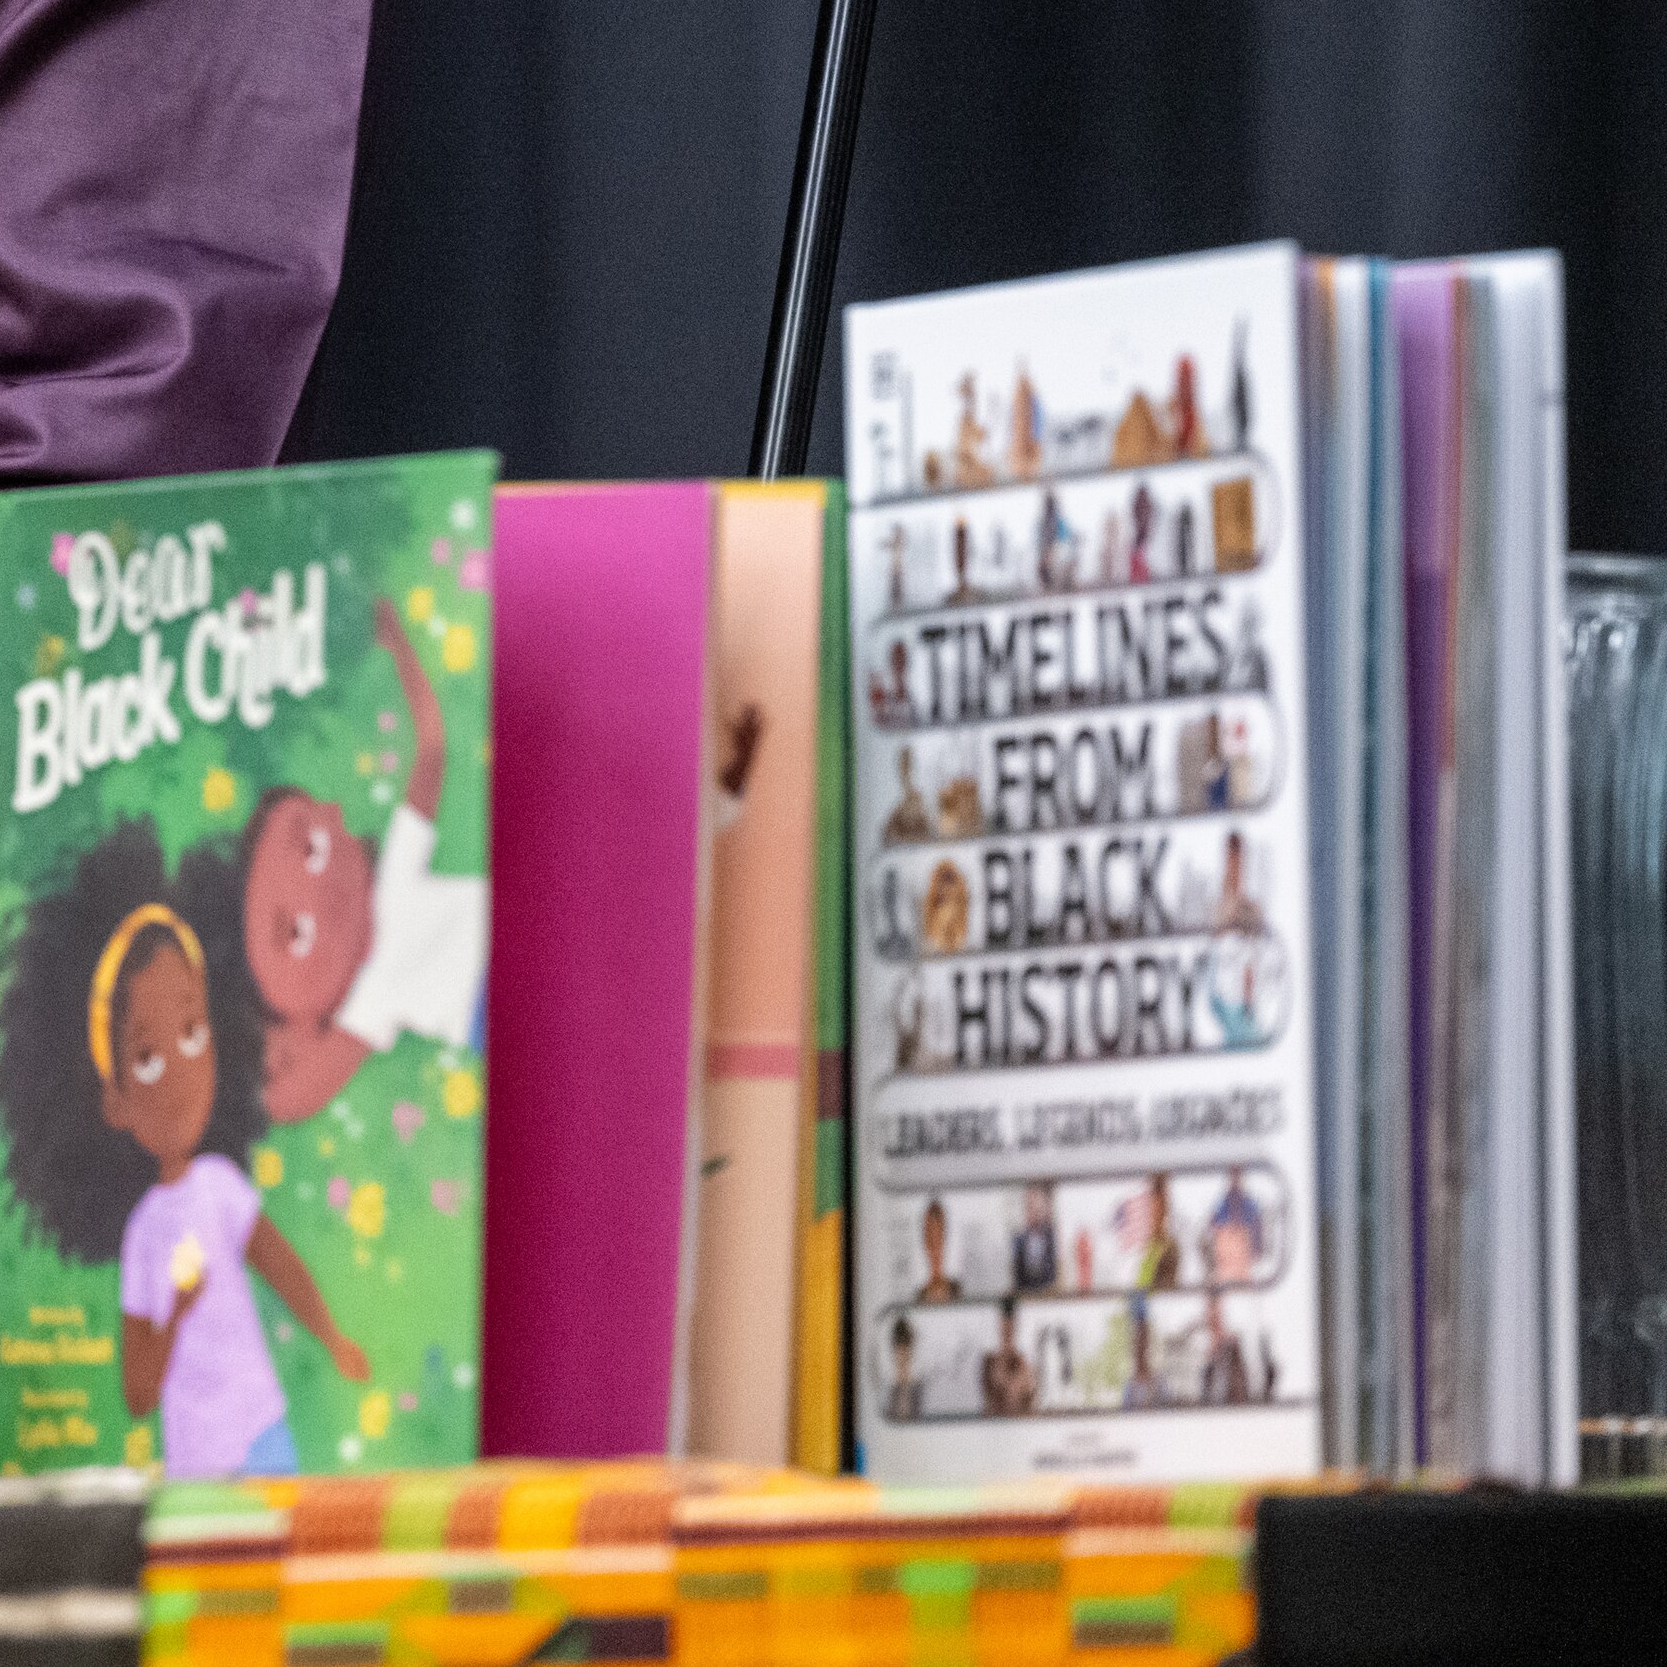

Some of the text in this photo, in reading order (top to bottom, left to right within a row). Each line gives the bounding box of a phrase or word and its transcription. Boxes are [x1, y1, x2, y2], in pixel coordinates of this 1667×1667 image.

[68, 520, 228, 652] Dear
[12, 562, 328, 813] Black Child
[920, 590, 1227, 723] TIMELINES
[994, 720, 1157, 834] FROM
[982, 836, 1171, 952] BLACK
[954, 948, 1214, 1072] HISTORY
